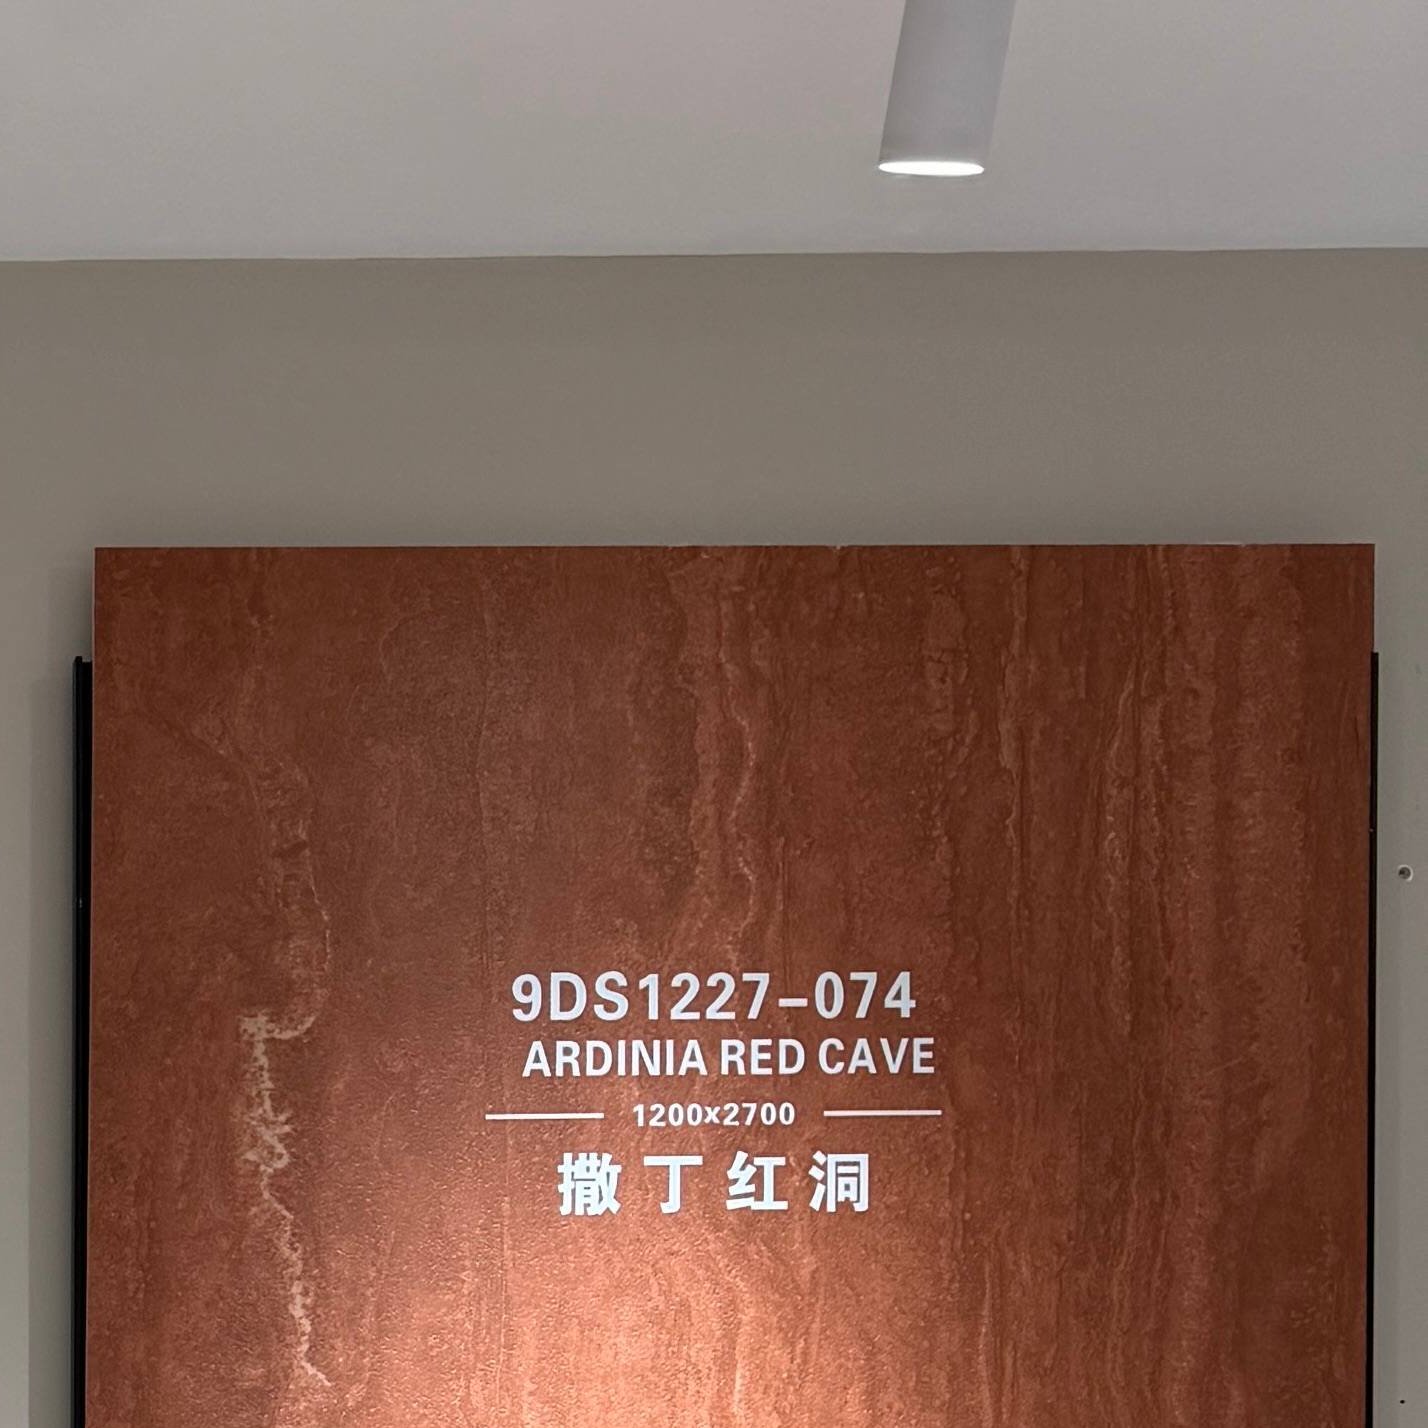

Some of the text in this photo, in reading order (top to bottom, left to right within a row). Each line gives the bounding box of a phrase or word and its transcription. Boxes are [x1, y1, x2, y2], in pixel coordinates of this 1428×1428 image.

[511, 970, 916, 1022] 9DS1227-074
[521, 1037, 936, 1077] ARDINIA RED CAVE
[632, 1102, 796, 1128] 1200x2700
[556, 1150, 870, 1217] 撒丁红洞
